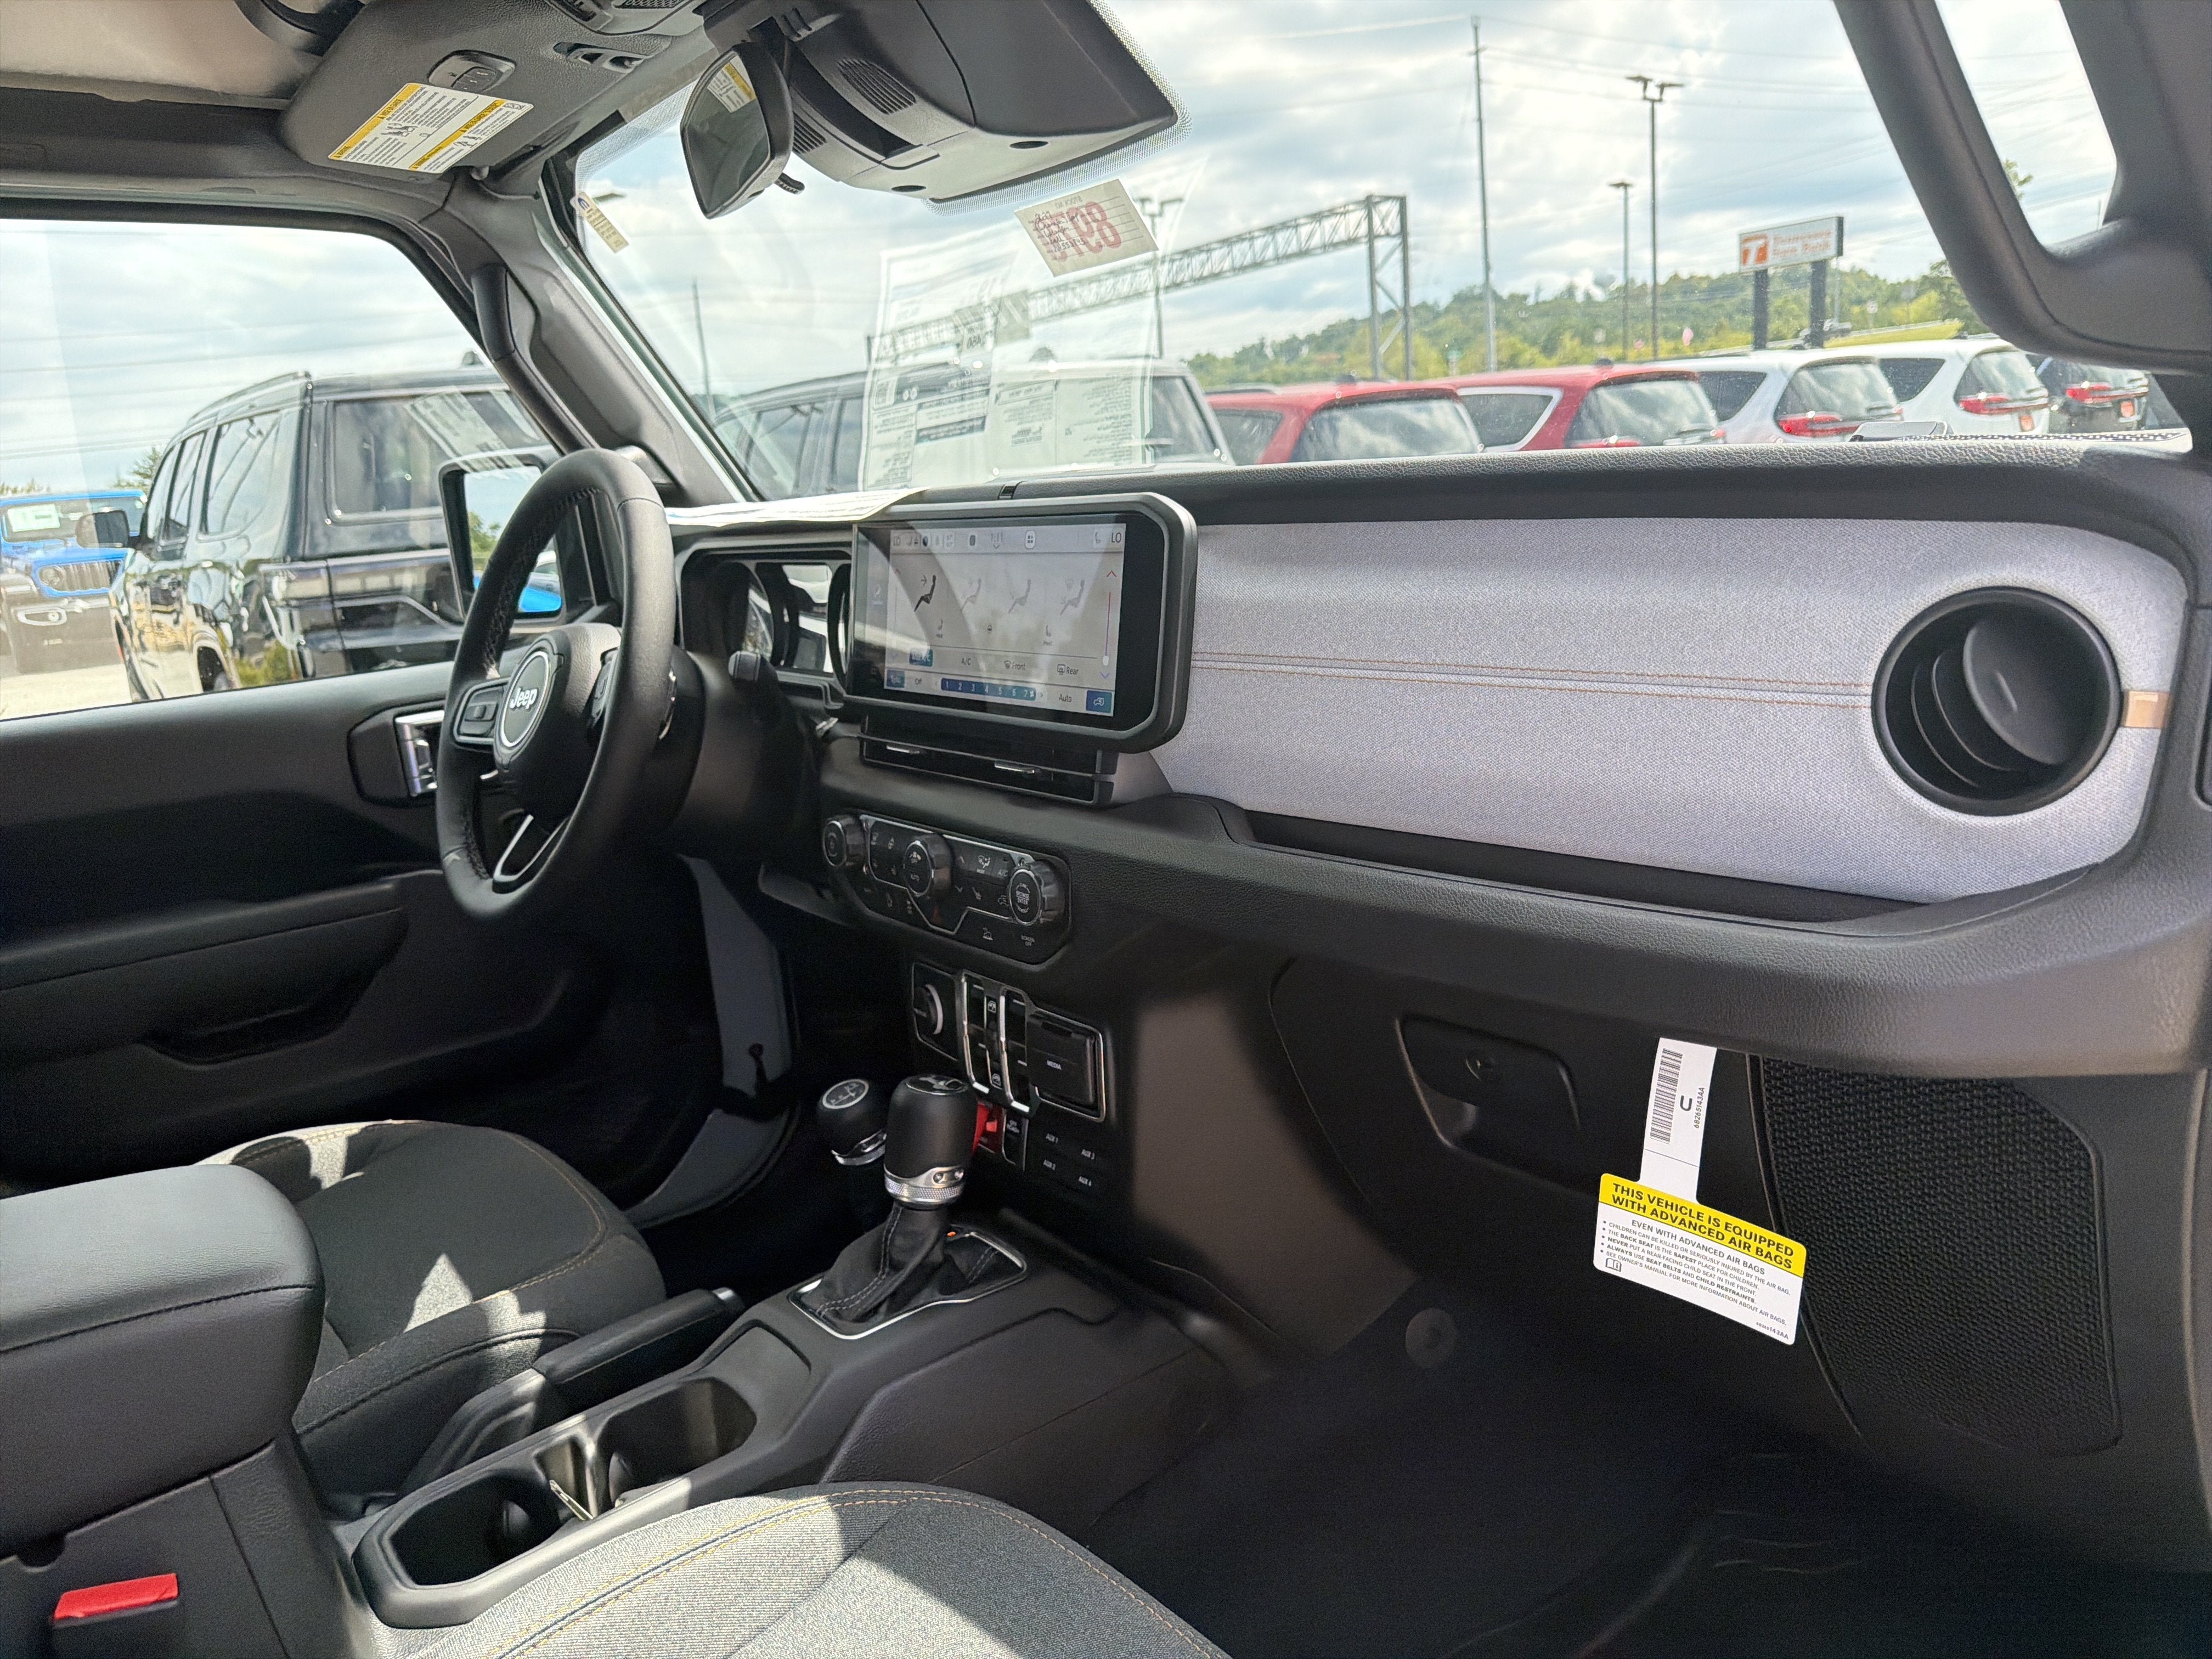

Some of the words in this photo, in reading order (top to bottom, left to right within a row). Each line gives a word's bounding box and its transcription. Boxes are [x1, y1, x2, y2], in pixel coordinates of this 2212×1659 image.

[1111, 532, 1122, 543] LO
[1012, 662, 1026, 671] Front
[1066, 666, 1079, 675] Rear
[510, 687, 537, 709] Jeep
[1058, 693, 1072, 703] Auto
[997, 869, 1008, 877] A/C
[1015, 890, 1030, 900] BROWSE
[1017, 898, 1029, 906] ENTER
[1047, 1060, 1062, 1070] MEDIA
[1680, 1095, 1692, 1111] U
[1693, 1087, 1705, 1129] 68265143AA
[1045, 1133, 1056, 1142] AUX
[1081, 1149, 1091, 1158] AUX
[1043, 1159, 1052, 1169] AUX
[1078, 1176, 1088, 1185] AUX
[1612, 1183, 1643, 1200] THIS
[1646, 1193, 1704, 1221] VEHICLE
[1707, 1215, 1720, 1228] IS
[1724, 1221, 1793, 1257] EQUIPPED
[1611, 1194, 1646, 1214] WITH
[1650, 1206, 1725, 1242] ADVANCED
[1728, 1235, 1751, 1252] AIR
[1755, 1246, 1792, 1269] BAGS
[1632, 1219, 1653, 1232] EVEN
[1655, 1227, 1677, 1240] WITH
[1679, 1235, 1724, 1258] ADVANCED
[1726, 1254, 1740, 1265] AIR
[1742, 1260, 1765, 1275] BAGS
[1609, 1221, 1637, 1235] CHILDREN
[1638, 1231, 1650, 1240] CAN
[1660, 1239, 1679, 1250] KILLED
[1689, 1250, 1720, 1266] SERIOUSLY
[1721, 1262, 1744, 1276] INJURED
[1754, 1276, 1765, 1284] THE
[1767, 1281, 1776, 1289] AIR
[1777, 1285, 1791, 1295] BAG.
[1620, 1233, 1637, 1243] BACK
[1638, 1239, 1653, 1248] SEAT
[1661, 1247, 1672, 1255] THE
[1673, 1251, 1696, 1264] SAFEST
[1697, 1261, 1716, 1272] PLACE
[1717, 1268, 1728, 1277] FOR
[1729, 1273, 1759, 1290] CHILDREN.
[1607, 1236, 1628, 1248] NEVER
[1646, 1249, 1683, 1267] REAR-FACING
[1684, 1263, 1701, 1273] CHILD
[1702, 1270, 1716, 1279] SEAT
[1724, 1279, 1735, 1288] THE
[1736, 1284, 1757, 1296] FRONT.
[1606, 1243, 1632, 1256] ALWAYS
[1634, 1252, 1645, 1261] USE
[1646, 1257, 1661, 1267] SEAT
[1662, 1263, 1681, 1273] BELTS
[1682, 1270, 1694, 1279] AND
[1696, 1275, 1715, 1286] CHILD
[1717, 1283, 1756, 1304] RESTRAINTS.
[1617, 1254, 1643, 1267] OWNER'S
[1644, 1264, 1668, 1277] MANUAL
[1681, 1277, 1697, 1288] MORE
[1699, 1284, 1737, 1304] INFORMATION
[1739, 1300, 1758, 1312] ABOUT
[1759, 1309, 1769, 1317] AIR
[1770, 1313, 1787, 1325] BAGS.
